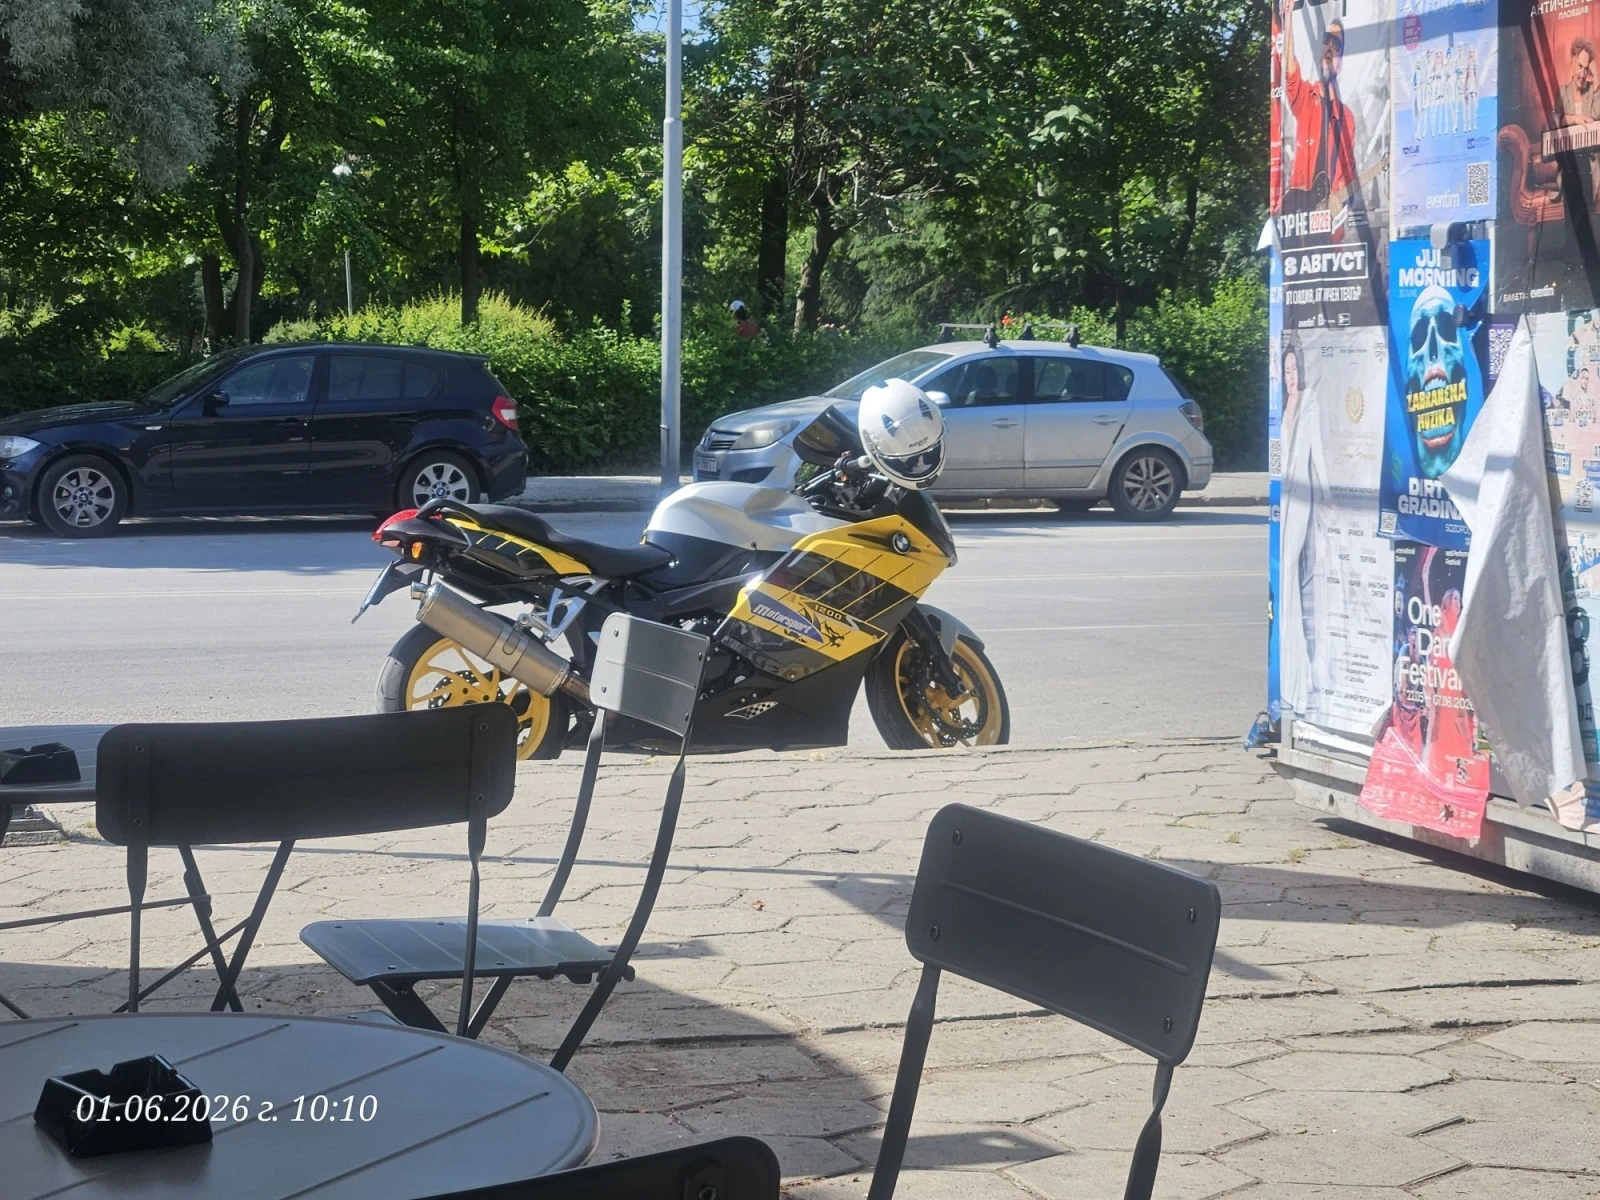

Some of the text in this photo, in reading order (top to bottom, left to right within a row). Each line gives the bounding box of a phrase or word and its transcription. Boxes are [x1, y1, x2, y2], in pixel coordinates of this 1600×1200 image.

[1310, 210, 1330, 233] 2026
[1284, 250, 1365, 276] 8 АВГУСТ
[1398, 267, 1479, 288] MORNING
[1417, 406, 1455, 432] MUZIKA
[1409, 477, 1444, 499] DIRT
[752, 603, 813, 634] Motorsport
[815, 603, 842, 620] 1200
[1408, 596, 1441, 627] One
